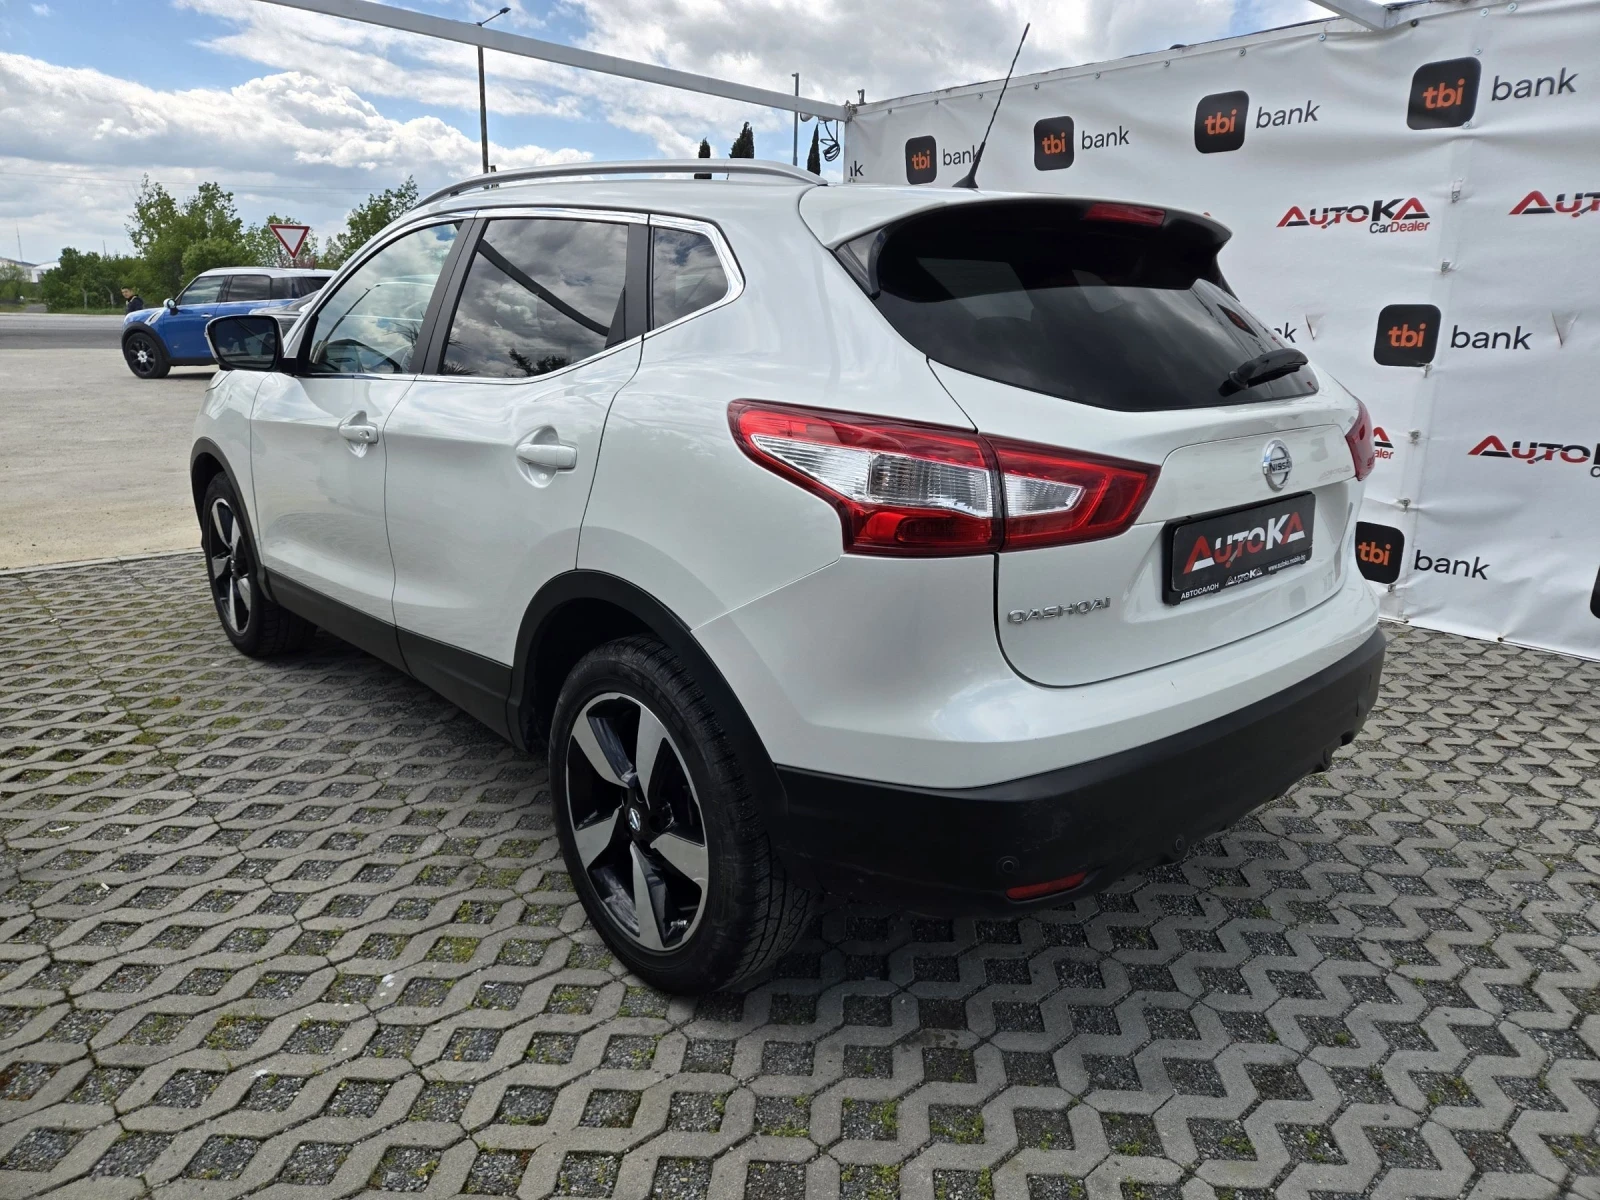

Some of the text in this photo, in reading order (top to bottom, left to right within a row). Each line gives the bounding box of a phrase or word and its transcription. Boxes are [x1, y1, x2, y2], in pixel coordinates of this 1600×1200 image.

[1422, 67, 1578, 109] tbi bank
[1204, 100, 1320, 135] tbi bank
[1042, 125, 1130, 154] tbi bank
[912, 149, 931, 170] tbi
[1369, 220, 1430, 234] CarDealer
[1388, 323, 1533, 350] tbi bank
[1467, 434, 1600, 465] AUTO
[1183, 511, 1306, 574] AUTOKA
[1358, 541, 1490, 580] tbi bank
[1181, 582, 1220, 600] АВТОСАЛОН
[1007, 596, 1111, 624] QASHQAI
